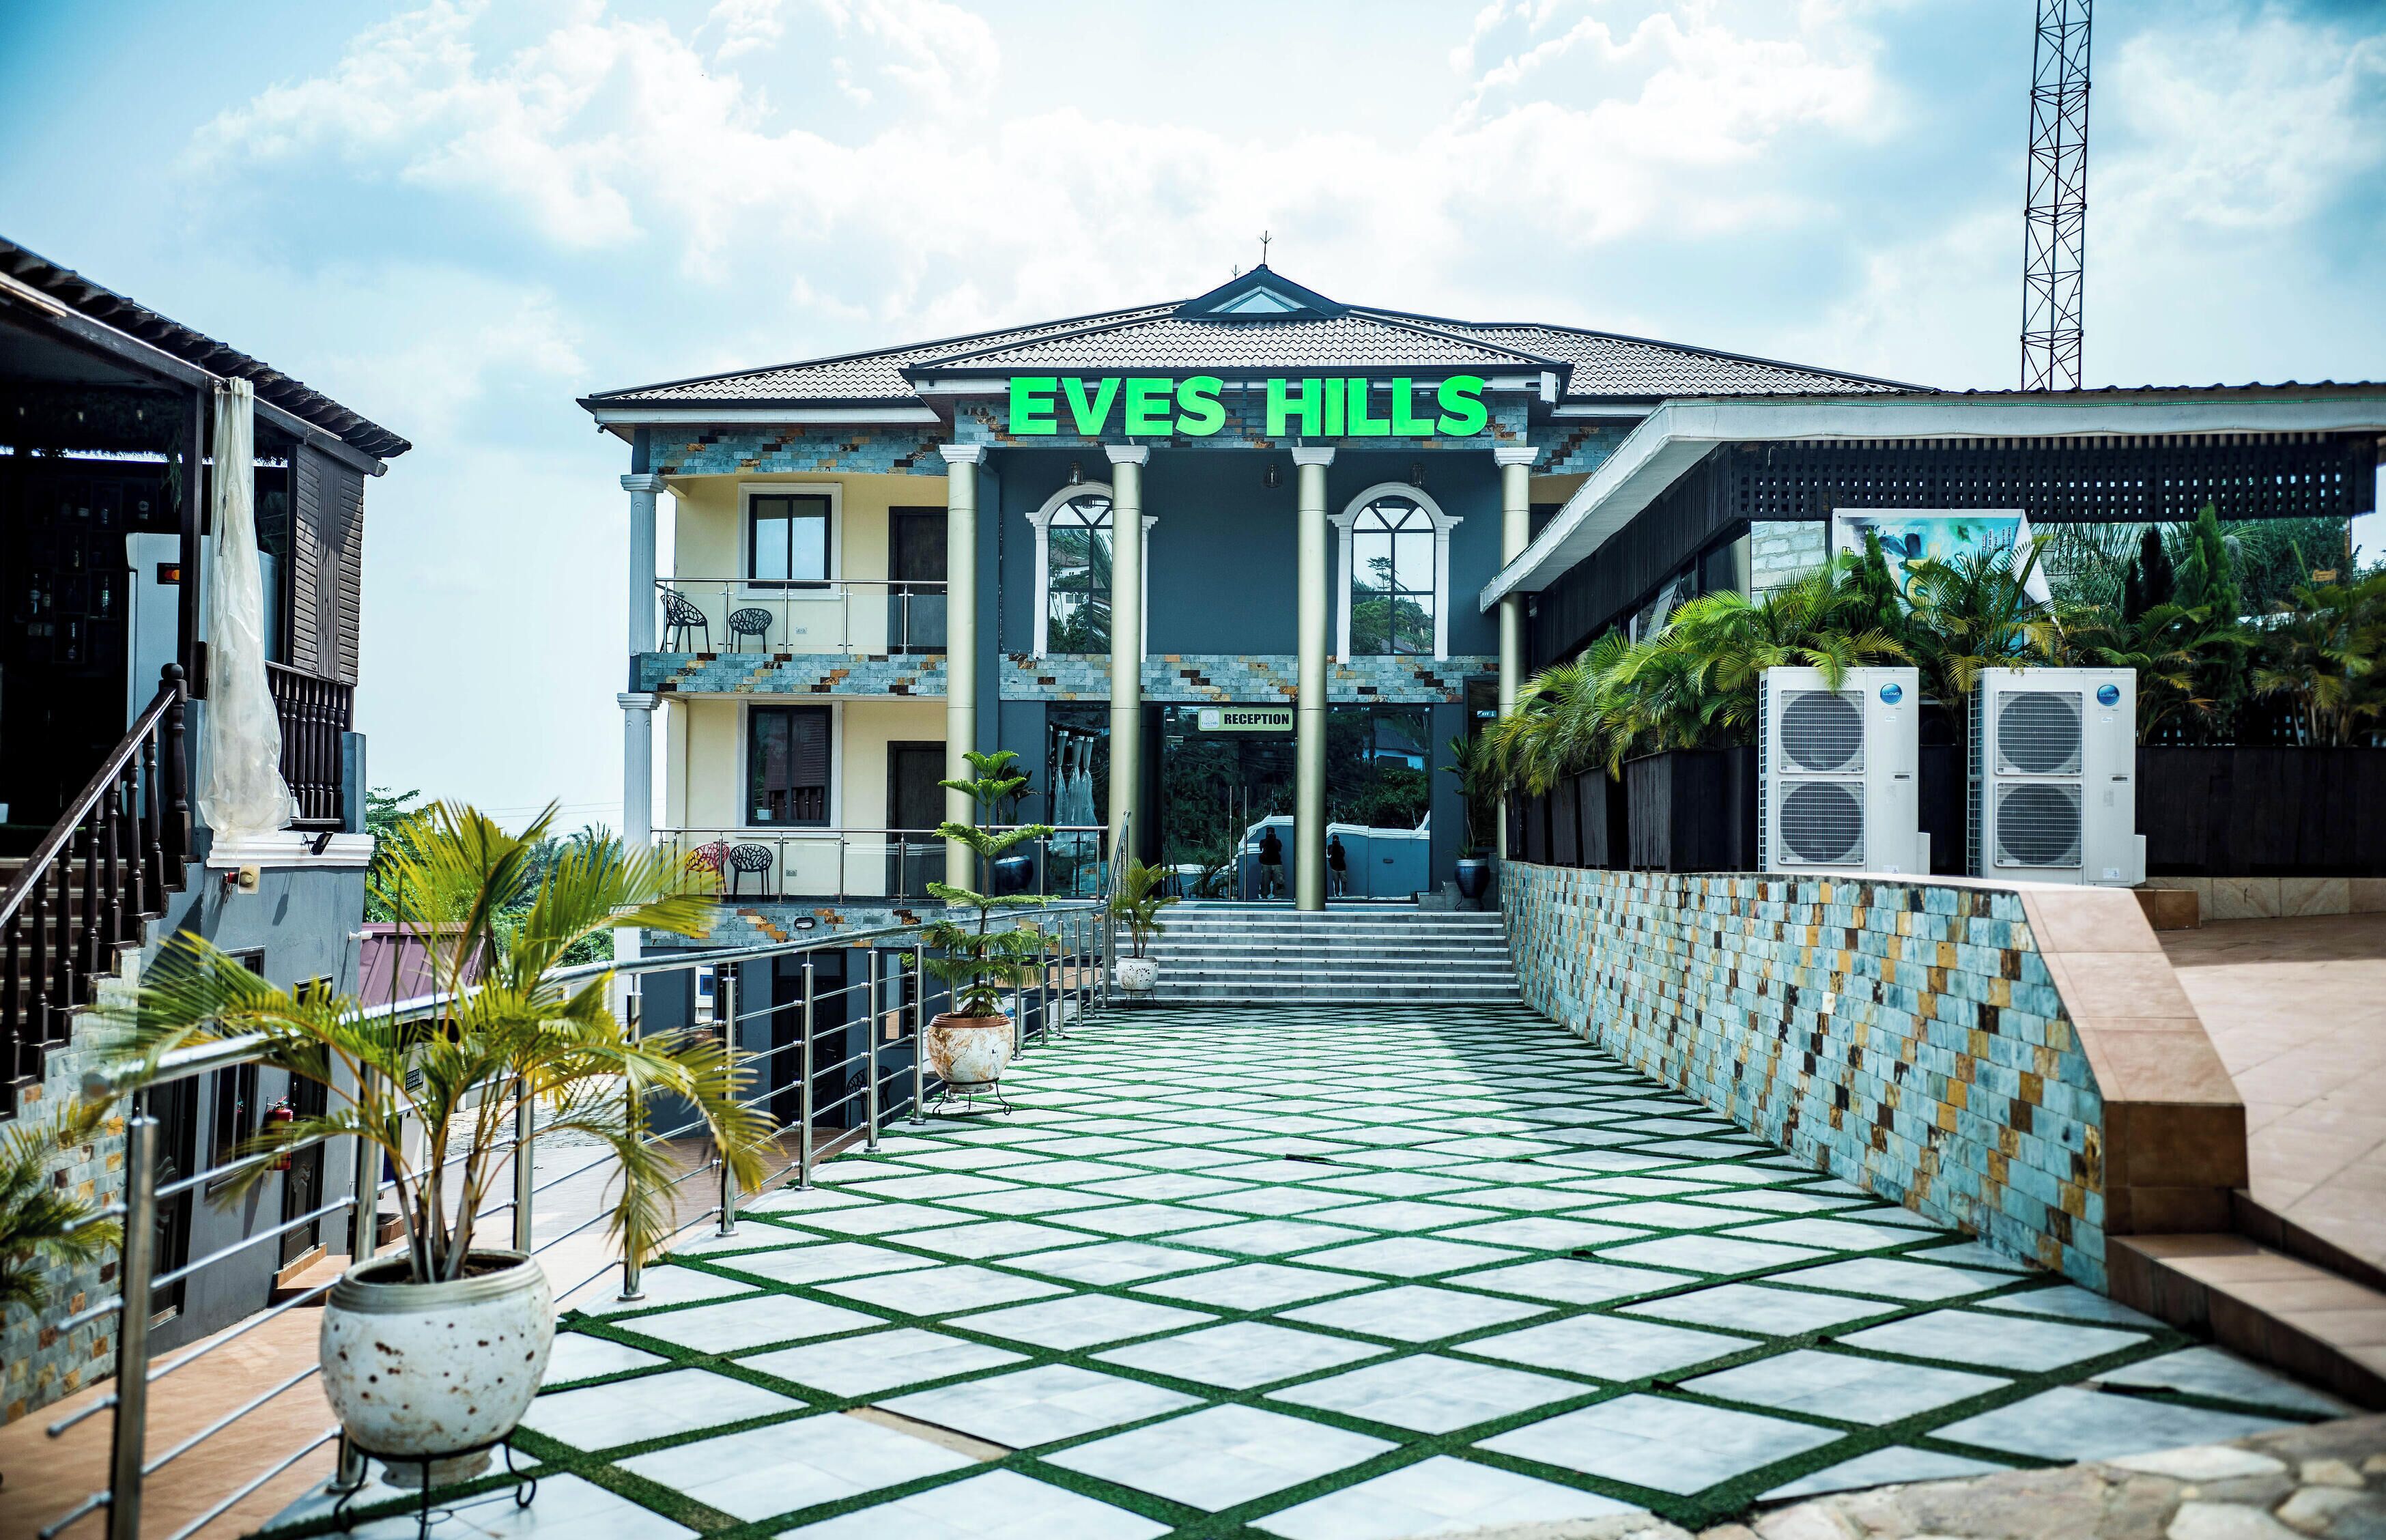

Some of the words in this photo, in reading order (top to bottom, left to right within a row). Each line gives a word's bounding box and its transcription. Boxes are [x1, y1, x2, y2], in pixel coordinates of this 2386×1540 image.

[1009, 375, 1226, 436] EVES
[1266, 375, 1488, 437] HILLS
[1224, 713, 1290, 725] RECEPTION
